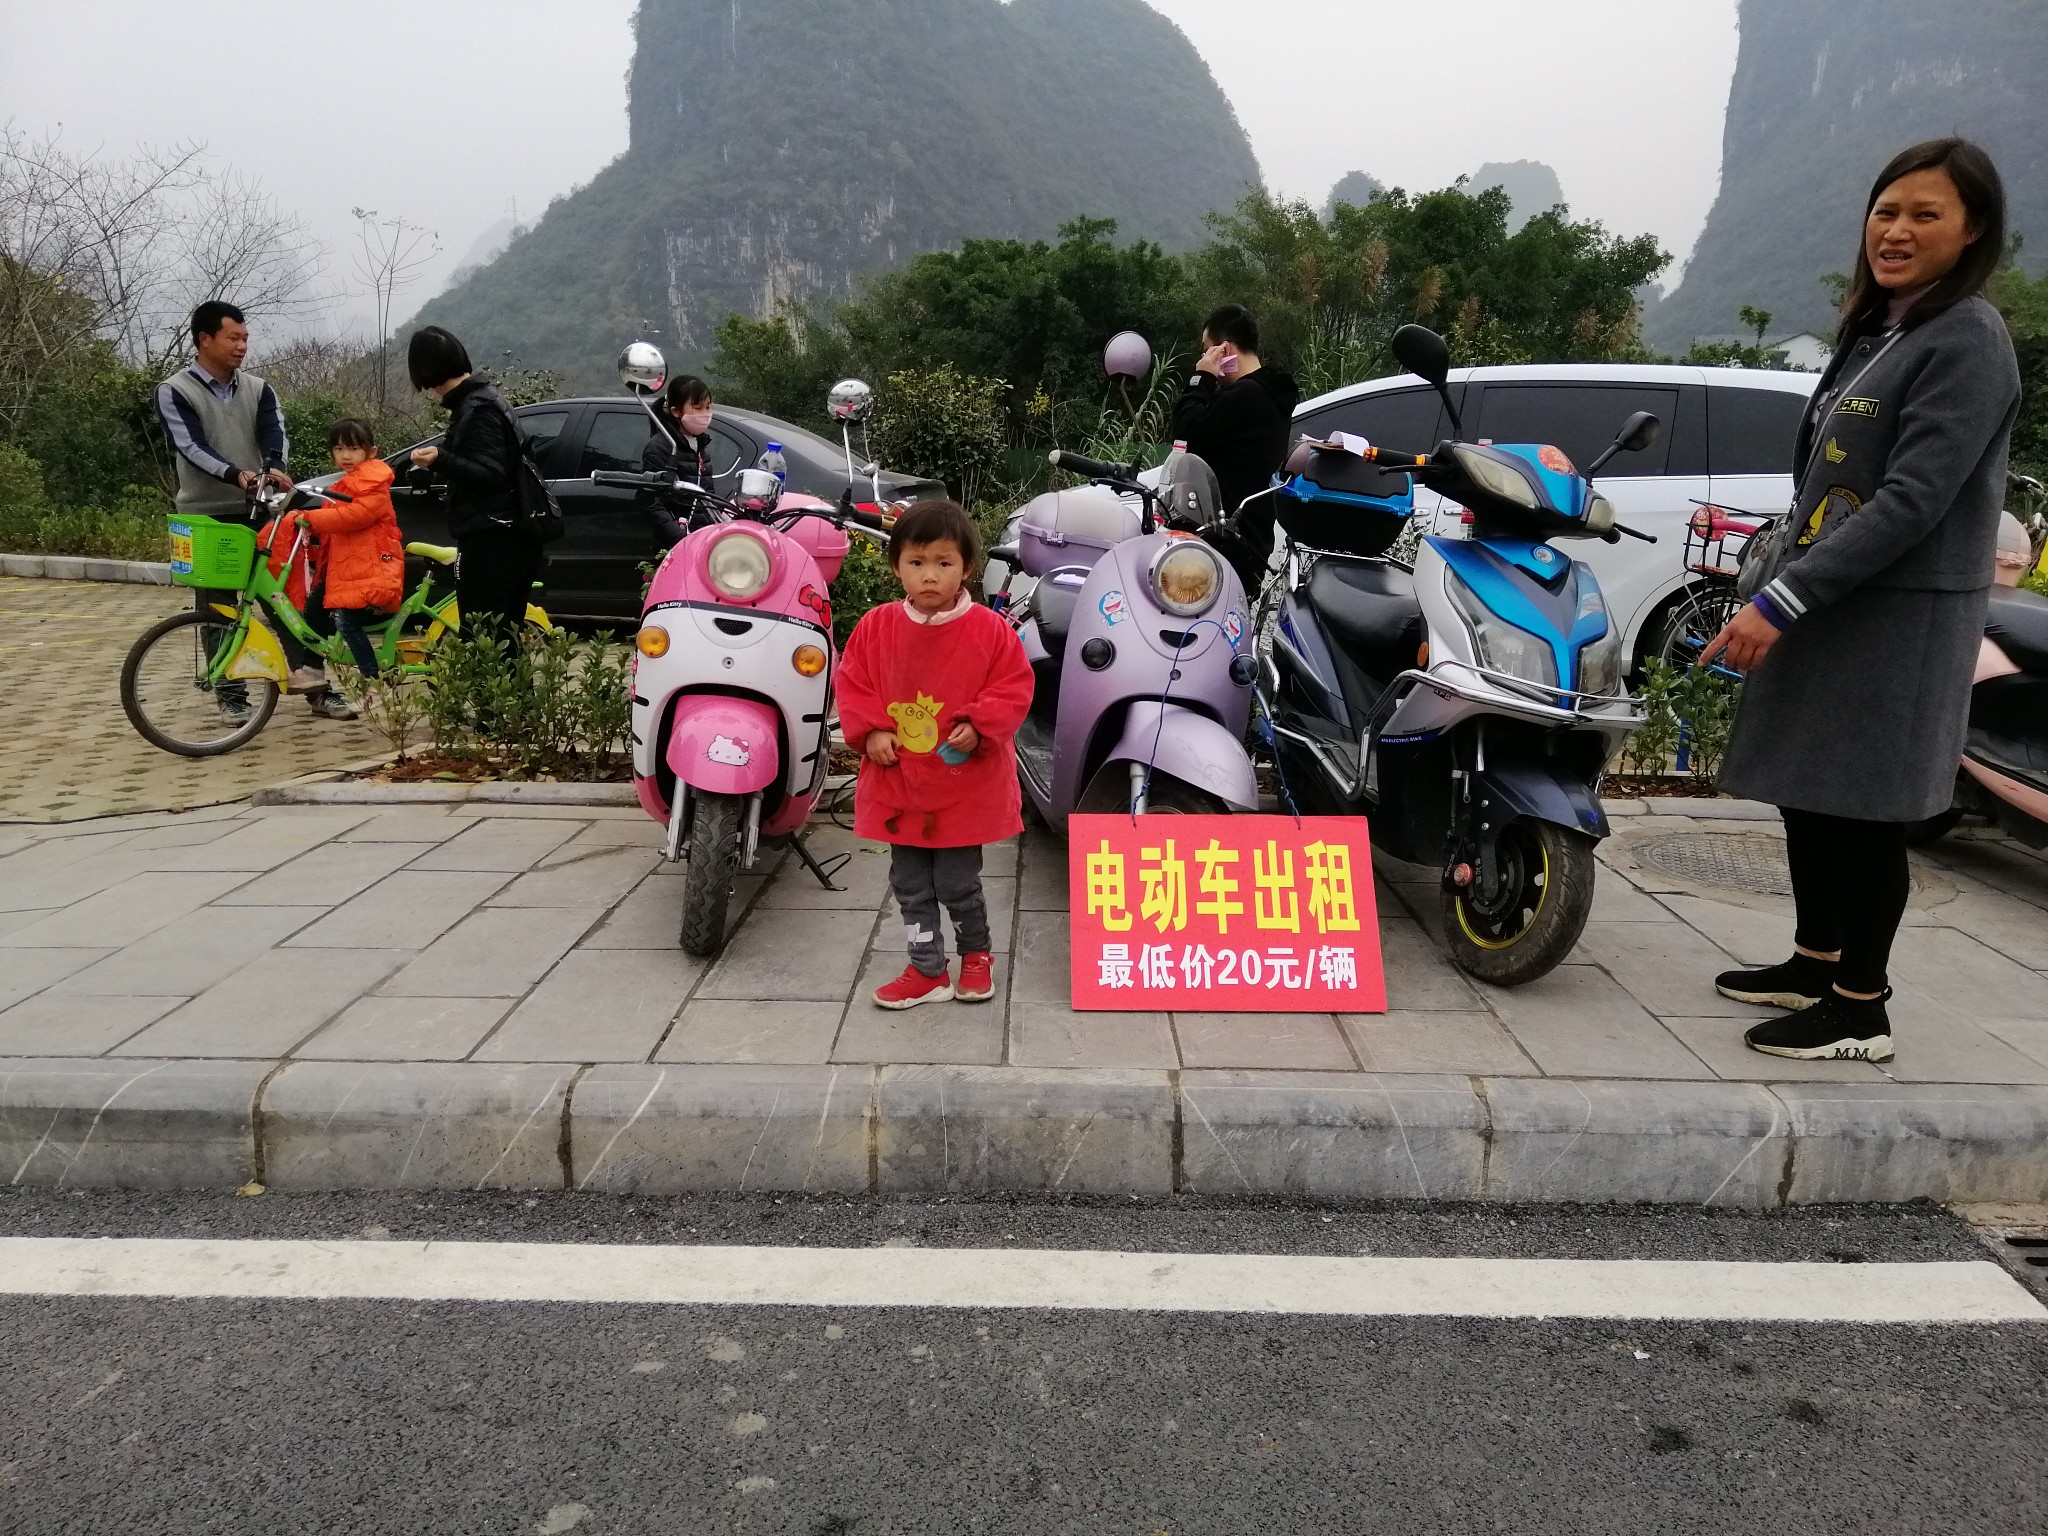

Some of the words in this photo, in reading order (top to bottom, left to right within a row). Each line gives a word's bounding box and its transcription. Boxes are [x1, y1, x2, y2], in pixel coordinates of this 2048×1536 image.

[1086, 838, 1361, 935] 电动车出租
[1098, 943, 1358, 990] 最低价20元/辆
